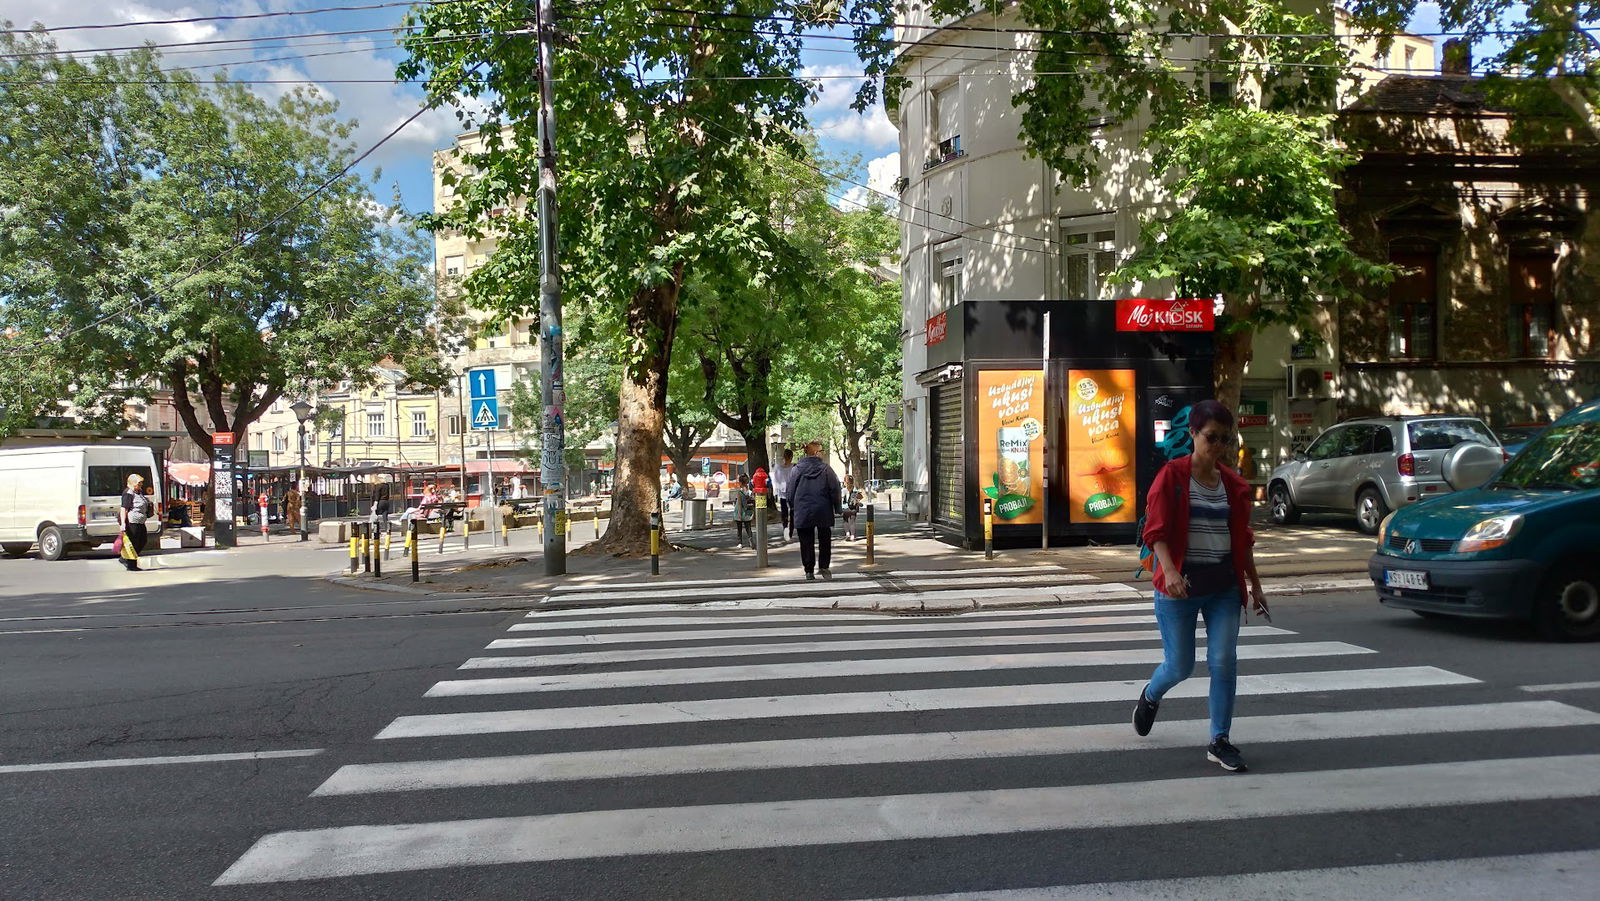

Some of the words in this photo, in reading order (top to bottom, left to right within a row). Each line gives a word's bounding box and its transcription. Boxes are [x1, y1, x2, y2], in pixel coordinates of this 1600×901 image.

[1127, 304, 1153, 327] Moj
[1155, 309, 1203, 325] KIOSK
[1000, 439, 1028, 448] ReMix
[999, 497, 1028, 513] PROBAJ!
[1088, 496, 1117, 512] PROBAJ!
